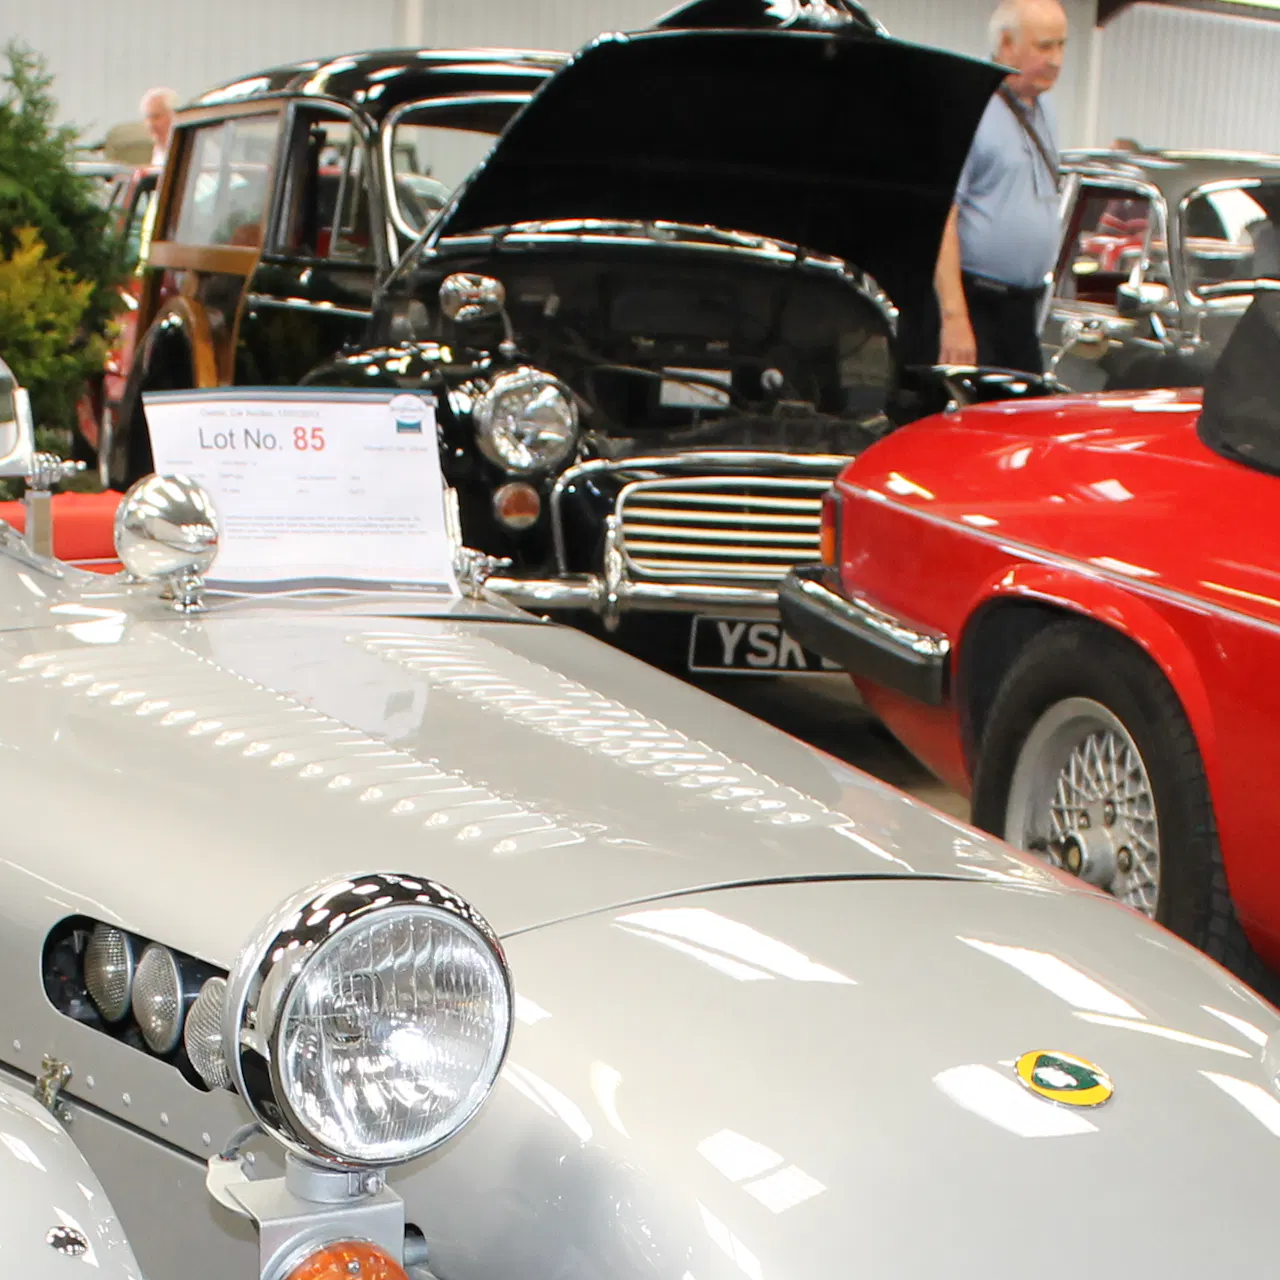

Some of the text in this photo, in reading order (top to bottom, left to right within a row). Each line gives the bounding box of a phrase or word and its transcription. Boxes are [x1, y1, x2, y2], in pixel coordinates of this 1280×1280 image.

[198, 426, 326, 451] Lot No. 85
